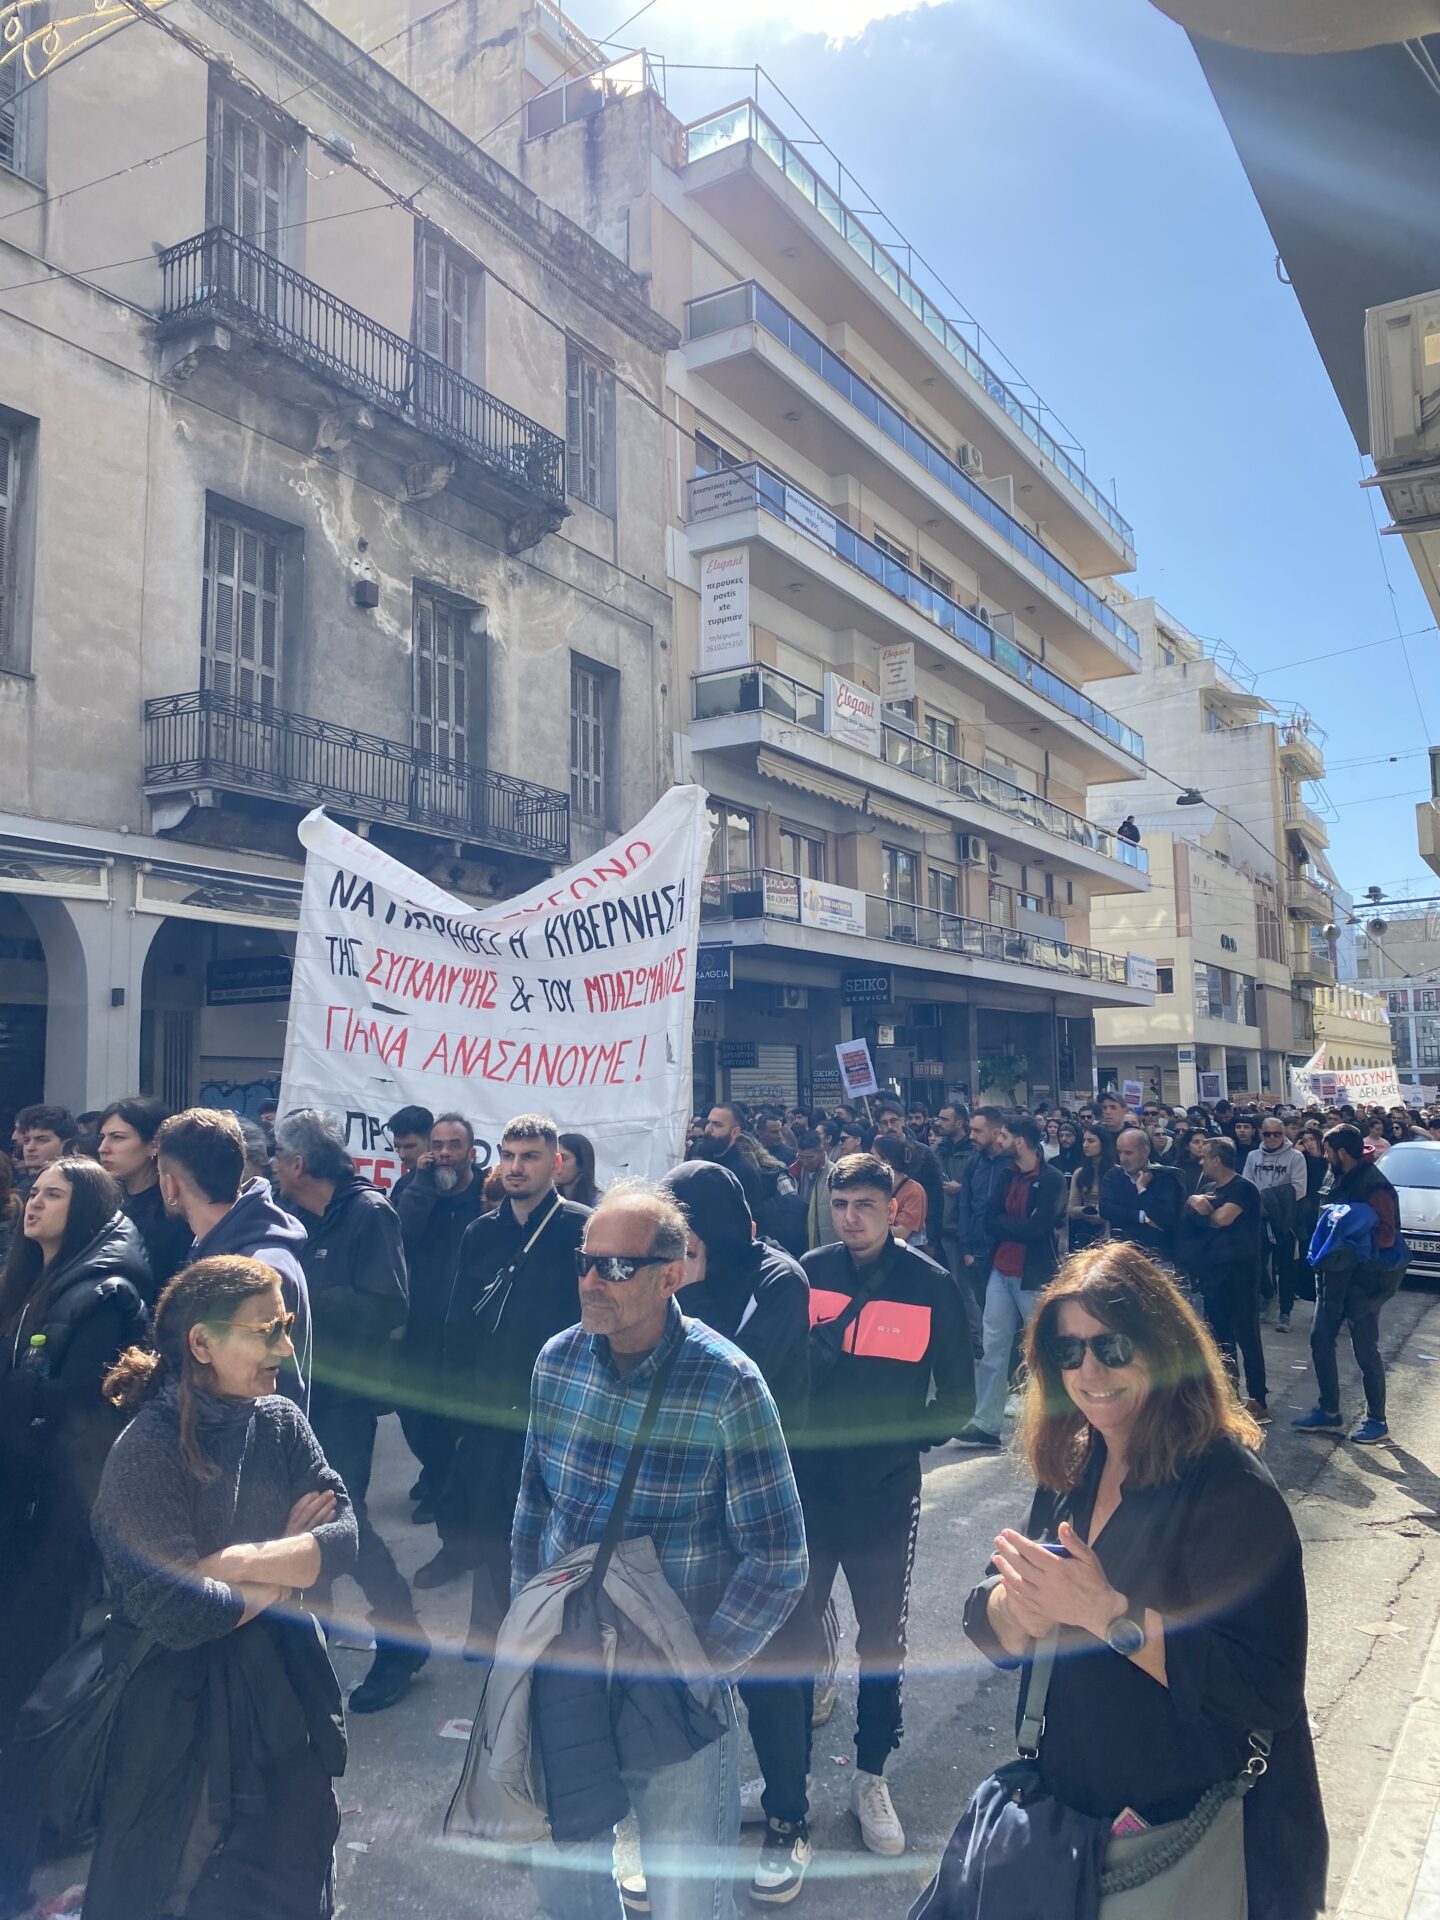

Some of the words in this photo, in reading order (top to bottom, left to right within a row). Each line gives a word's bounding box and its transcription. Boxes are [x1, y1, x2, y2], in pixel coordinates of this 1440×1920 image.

[706, 554, 743, 574] Elegant
[706, 577, 743, 591] περούκες
[713, 589, 736, 602] postis
[708, 614, 742, 626] τυρμπάν
[836, 683, 875, 719] Elegant
[329, 870, 375, 918] ΝΑ
[365, 948, 498, 1009] ΣΥΓΚΑΛΥΨΗΣ
[510, 976, 534, 1013] &
[538, 978, 575, 1013] ΤΟΥ
[845, 977, 888, 992] SEIKO
[846, 994, 889, 1002] SERVICE
[813, 1070, 839, 1078] SEIKO
[1360, 1088, 1377, 1098] ΔΕΝ
